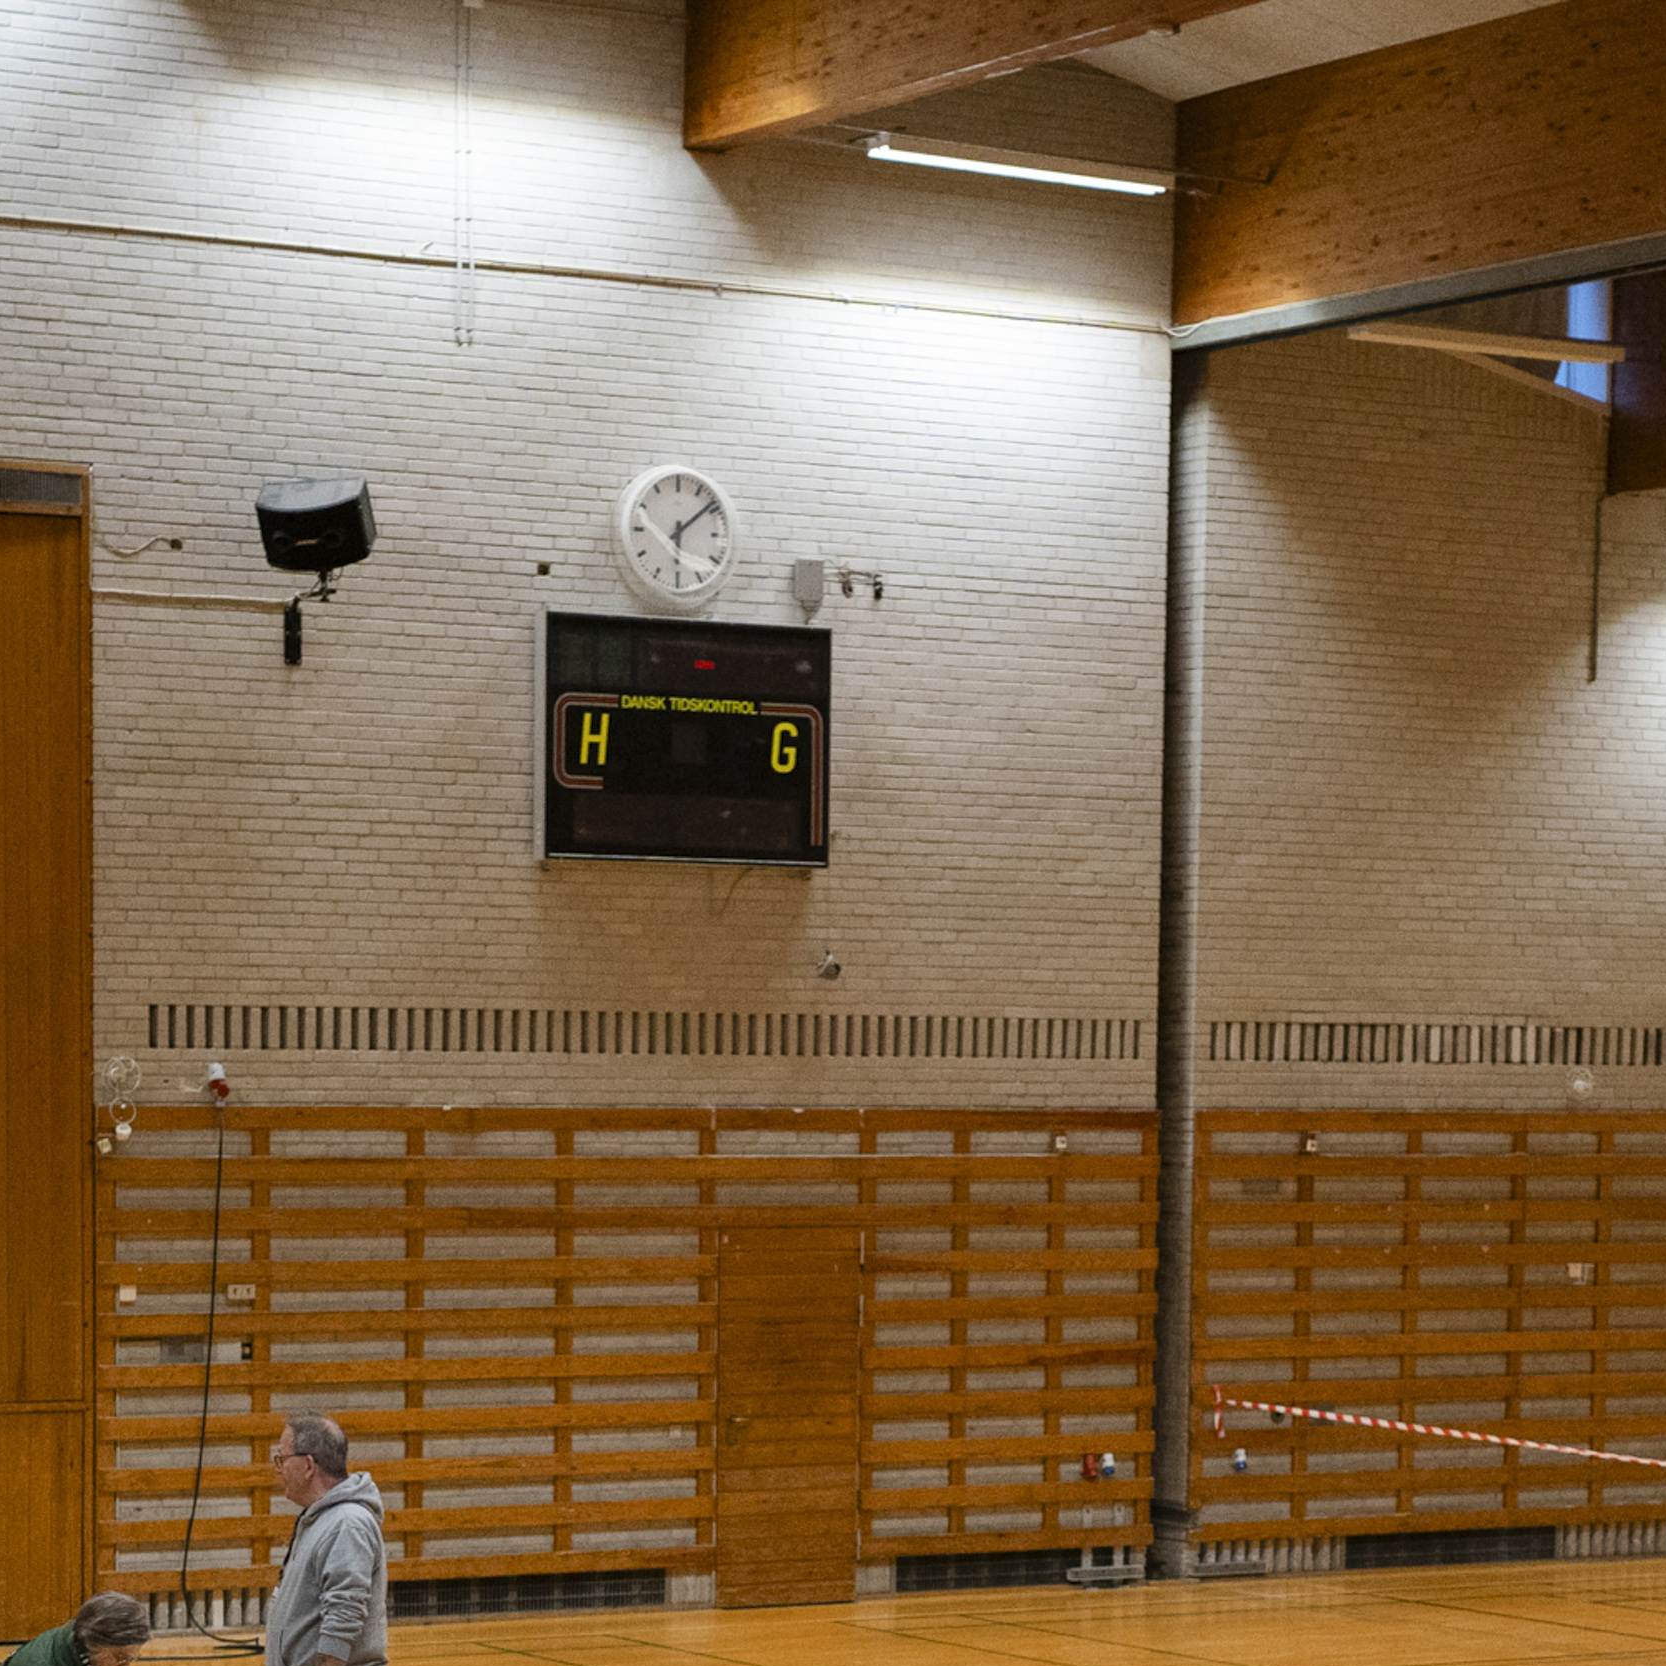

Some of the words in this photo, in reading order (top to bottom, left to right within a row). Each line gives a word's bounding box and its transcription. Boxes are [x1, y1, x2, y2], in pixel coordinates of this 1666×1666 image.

[621, 694, 667, 711] DANSK
[668, 696, 759, 716] TIDSKONTROL
[579, 712, 610, 765] H
[770, 721, 799, 774] G
